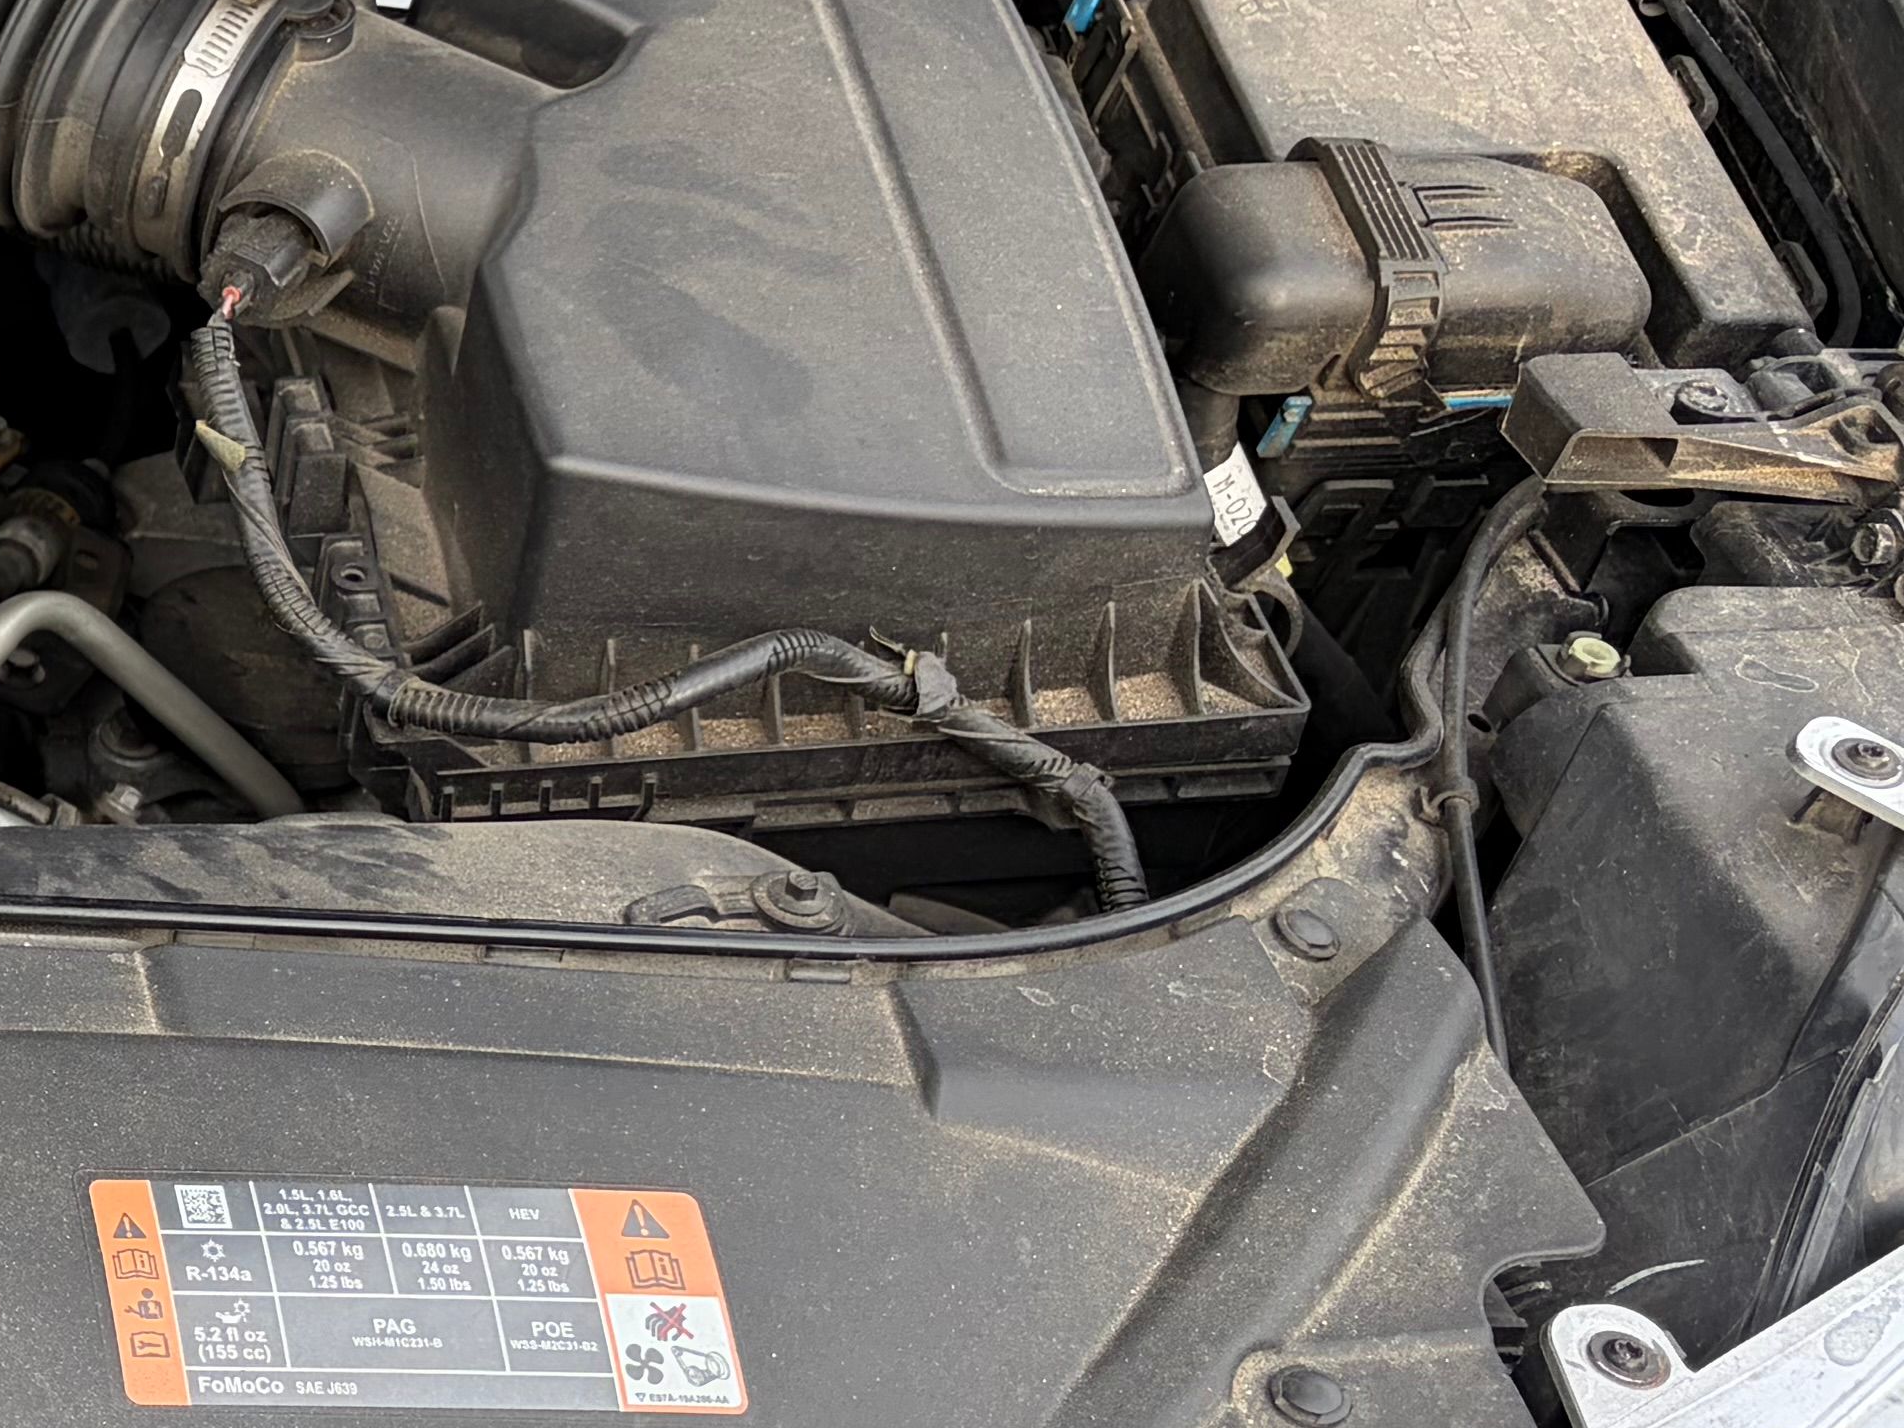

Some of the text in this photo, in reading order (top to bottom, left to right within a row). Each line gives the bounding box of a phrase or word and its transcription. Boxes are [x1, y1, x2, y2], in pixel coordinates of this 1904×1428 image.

[279, 1189, 352, 1203] 1.5L, 1.6L,
[263, 1203, 370, 1216] 2.0L, 3.7L GCC
[386, 1205, 466, 1218] 2.5L & 3.7L
[508, 1208, 540, 1220] HEV
[280, 1218, 365, 1231] & 2.5L E100
[293, 1241, 364, 1260] 0.567 kg
[402, 1243, 472, 1262] 0.680 kg
[501, 1245, 570, 1265] 0.567 kg
[313, 1259, 352, 1273] 20 oz
[421, 1261, 460, 1274] 24 oz
[521, 1264, 558, 1277] 20 oz
[185, 1266, 252, 1282] R-134a
[309, 1275, 363, 1289] 1.25 lbs
[417, 1277, 472, 1291] 1.50 lbs
[517, 1279, 570, 1293] 1.25 lbs
[372, 1318, 417, 1335] PAG
[531, 1321, 576, 1338] POE
[194, 1326, 268, 1343] 5.2 fl oz
[198, 1344, 271, 1363] (155 cc)
[198, 1376, 358, 1395] FoMoCo SAE J639
